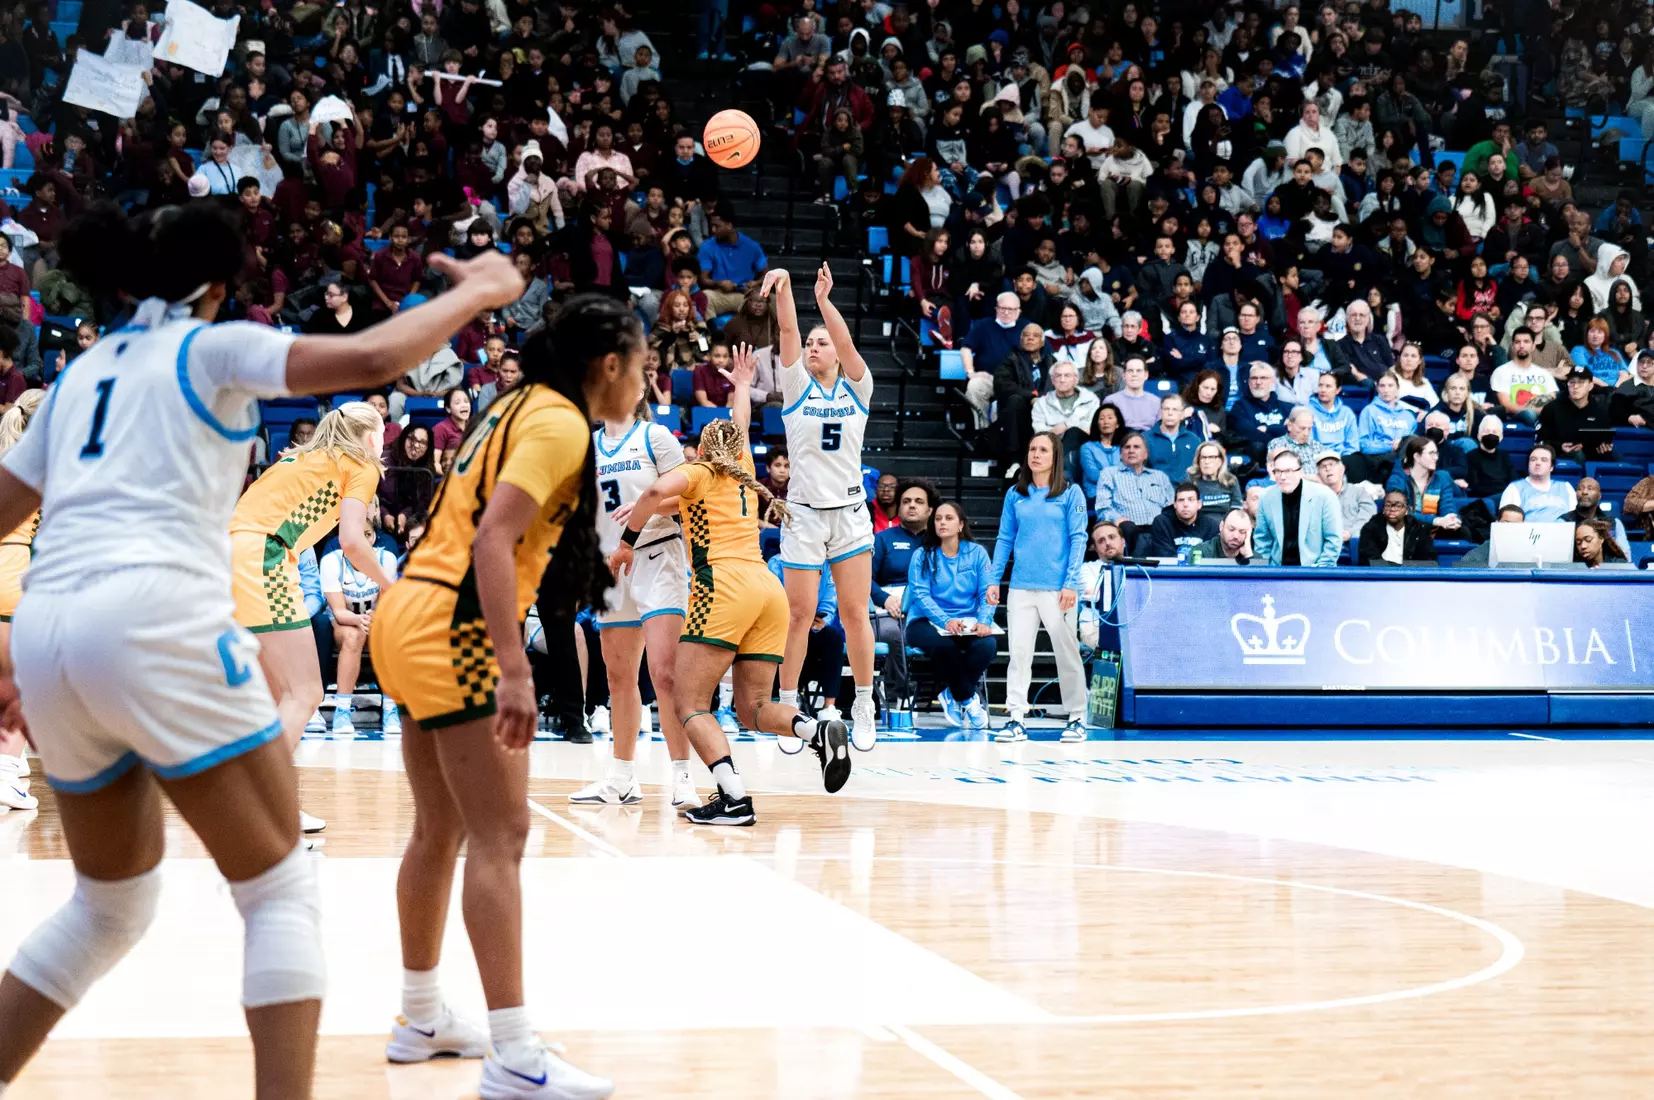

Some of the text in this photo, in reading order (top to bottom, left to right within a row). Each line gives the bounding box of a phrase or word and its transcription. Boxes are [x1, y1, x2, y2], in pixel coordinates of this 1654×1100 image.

[1511, 374, 1546, 385] ELMO
[79, 377, 117, 460] 1
[803, 404, 857, 418] COLUMBIA
[821, 422, 843, 452] 5
[599, 460, 642, 476] UMBIA
[600, 479, 622, 513] 3
[1528, 528, 1541, 546] hp
[1333, 619, 1618, 666] COLUMBIA
